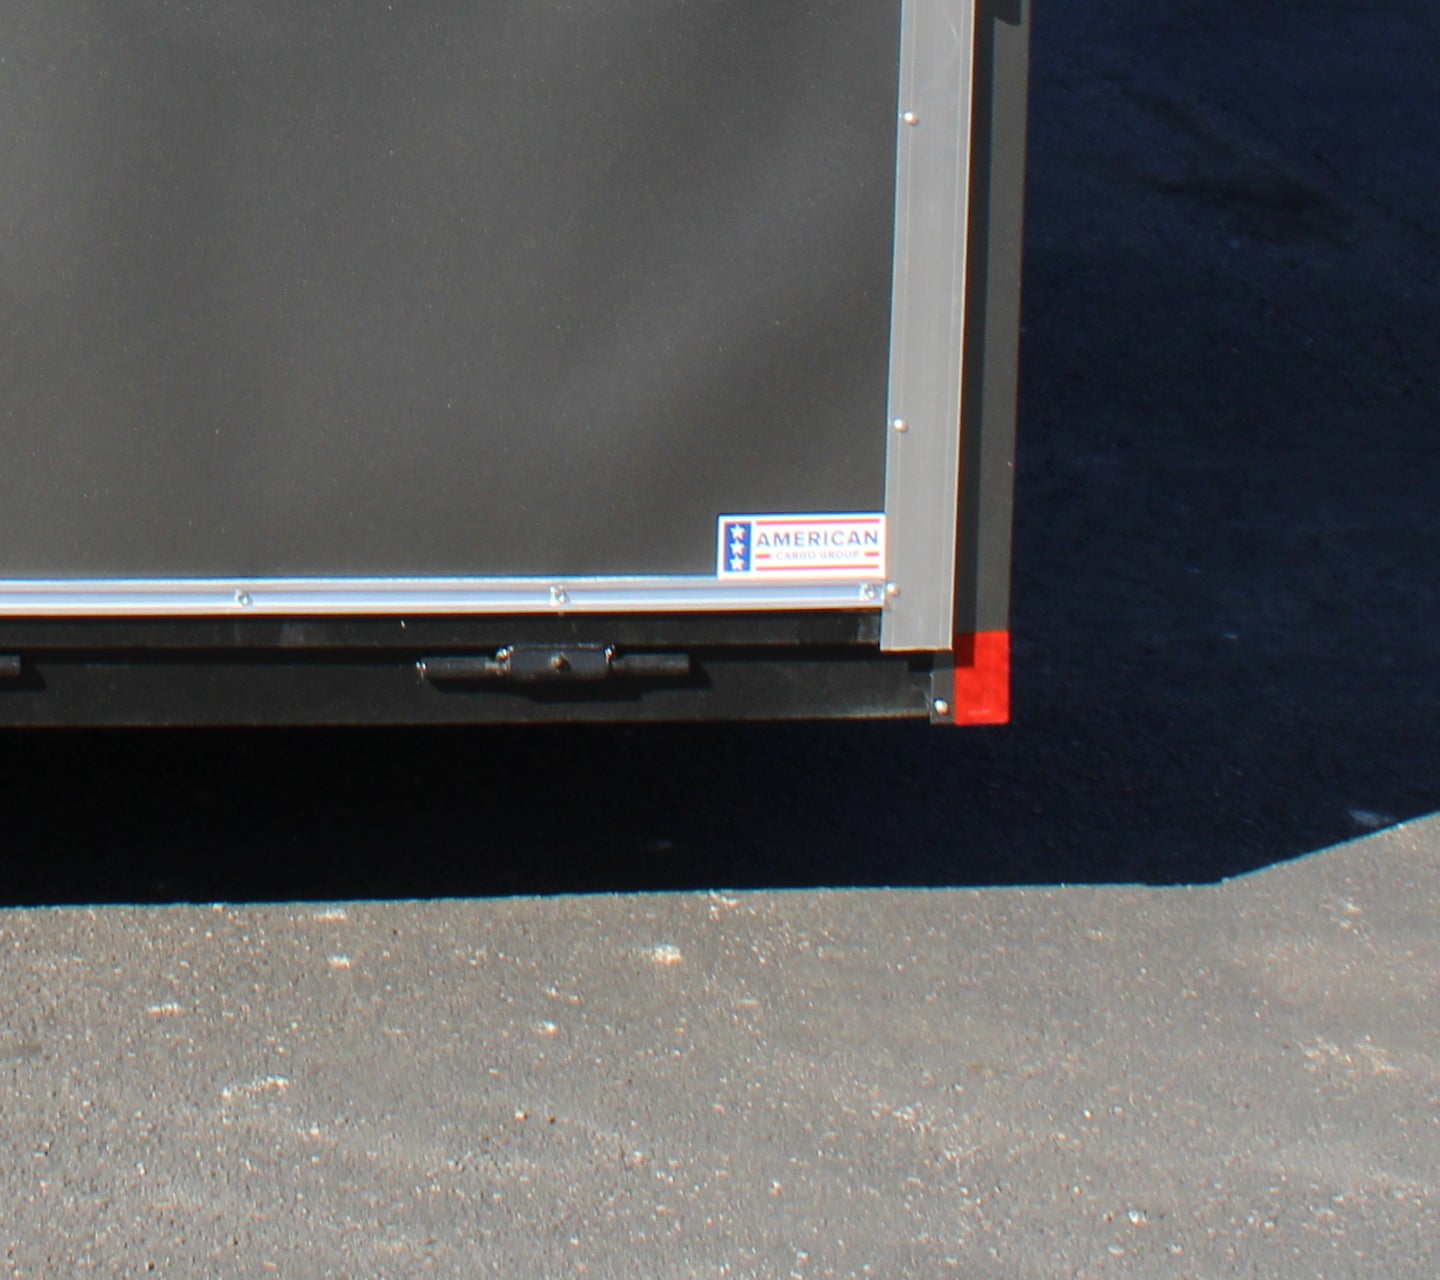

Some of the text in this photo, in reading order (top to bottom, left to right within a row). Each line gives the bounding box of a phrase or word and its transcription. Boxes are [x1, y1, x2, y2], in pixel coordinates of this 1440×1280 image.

[756, 529, 879, 547] AMERICAN
[776, 549, 860, 561] CARGO GROUP
